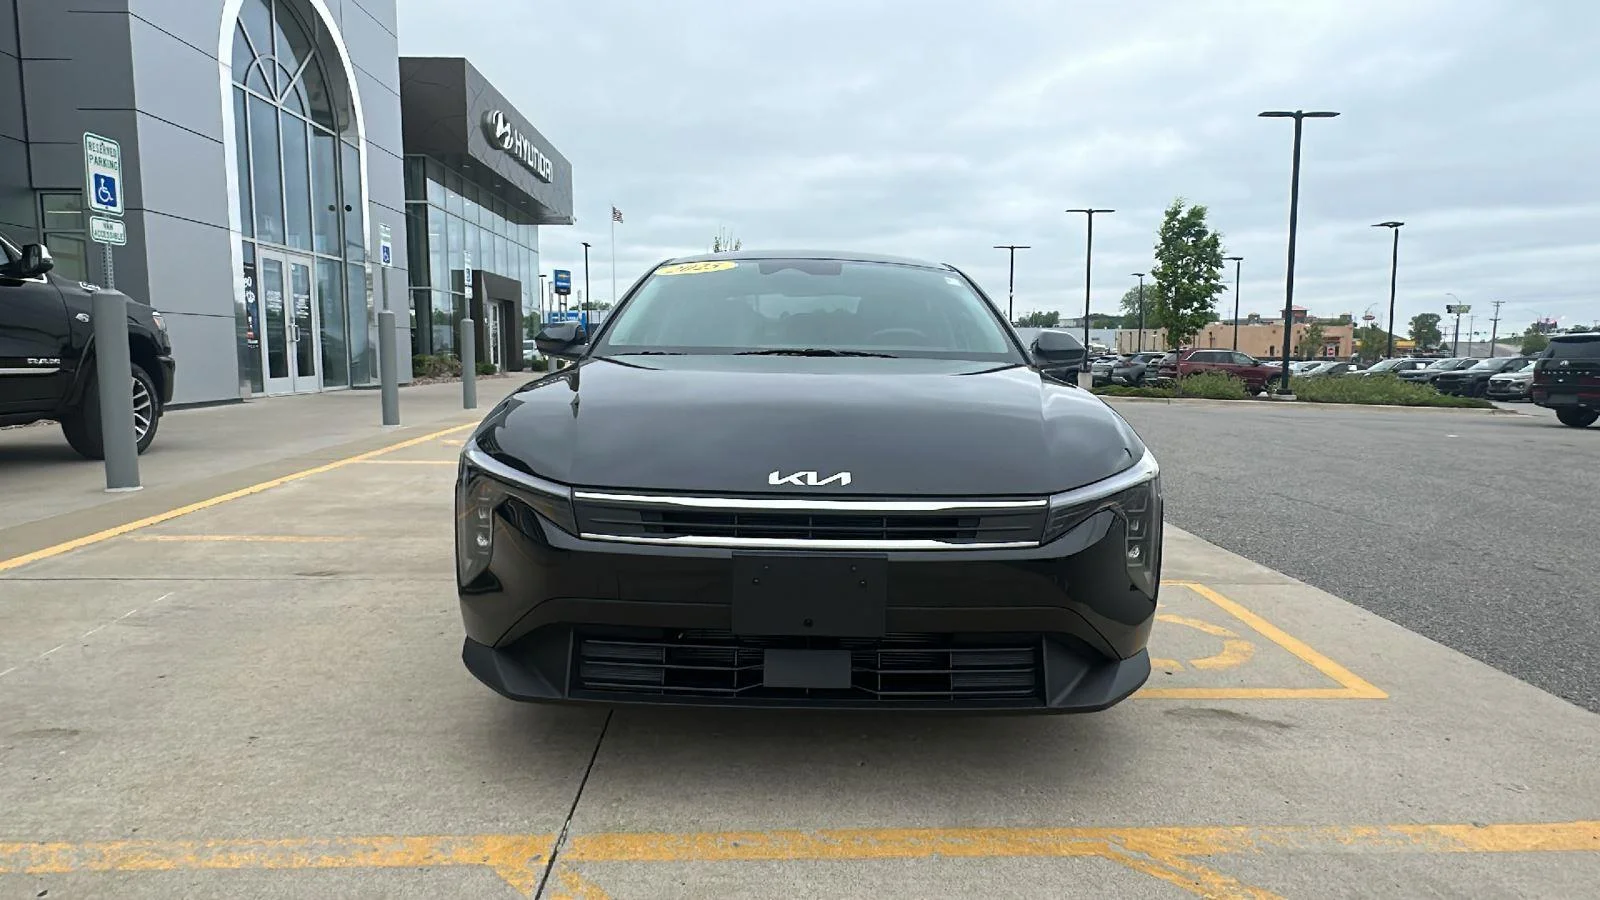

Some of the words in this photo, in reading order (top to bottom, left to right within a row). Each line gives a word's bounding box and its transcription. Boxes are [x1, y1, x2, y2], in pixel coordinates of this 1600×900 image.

[87, 140, 117, 158] RESERVED
[514, 129, 553, 183] HYUNDAI
[89, 154, 118, 171] PARKING
[768, 471, 852, 486] KIA
